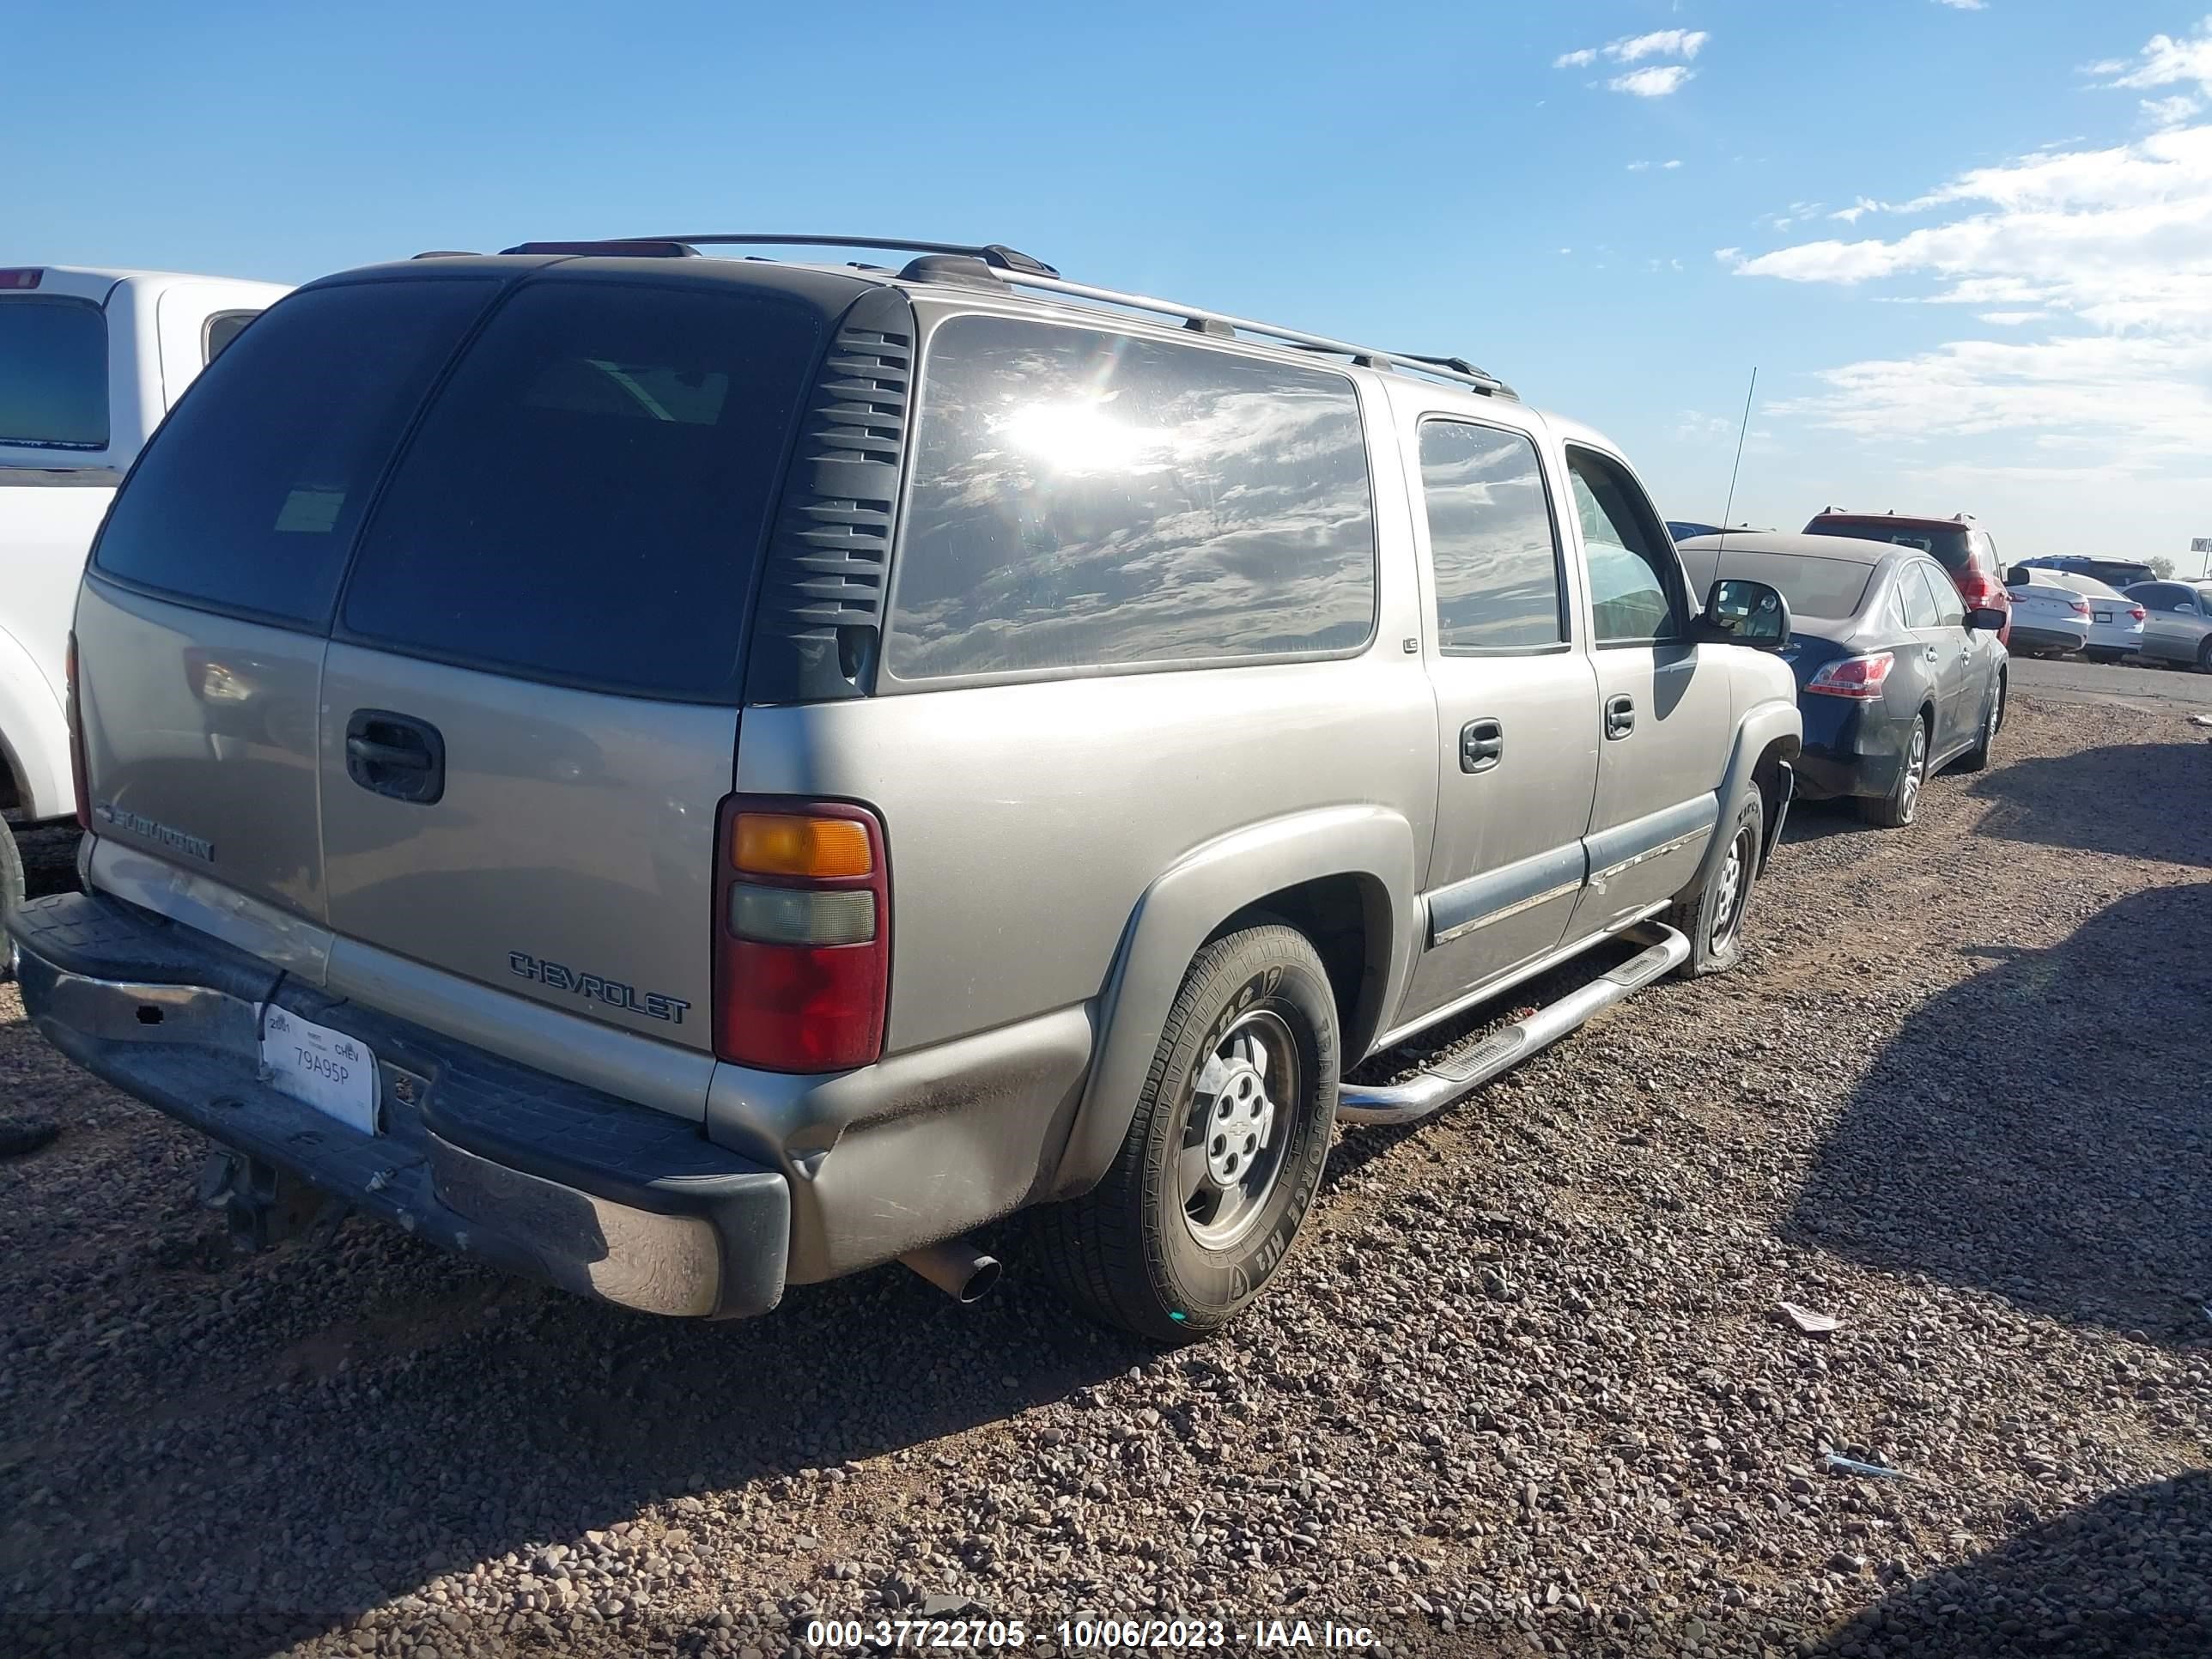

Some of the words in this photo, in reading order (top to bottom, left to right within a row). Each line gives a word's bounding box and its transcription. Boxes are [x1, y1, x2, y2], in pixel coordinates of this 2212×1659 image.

[507, 950, 691, 1024] CHEVROLET
[295, 1046, 349, 1085] 79A95P
[334, 1043, 359, 1063] CHEV
[1255, 1229, 1285, 1272] HT2
